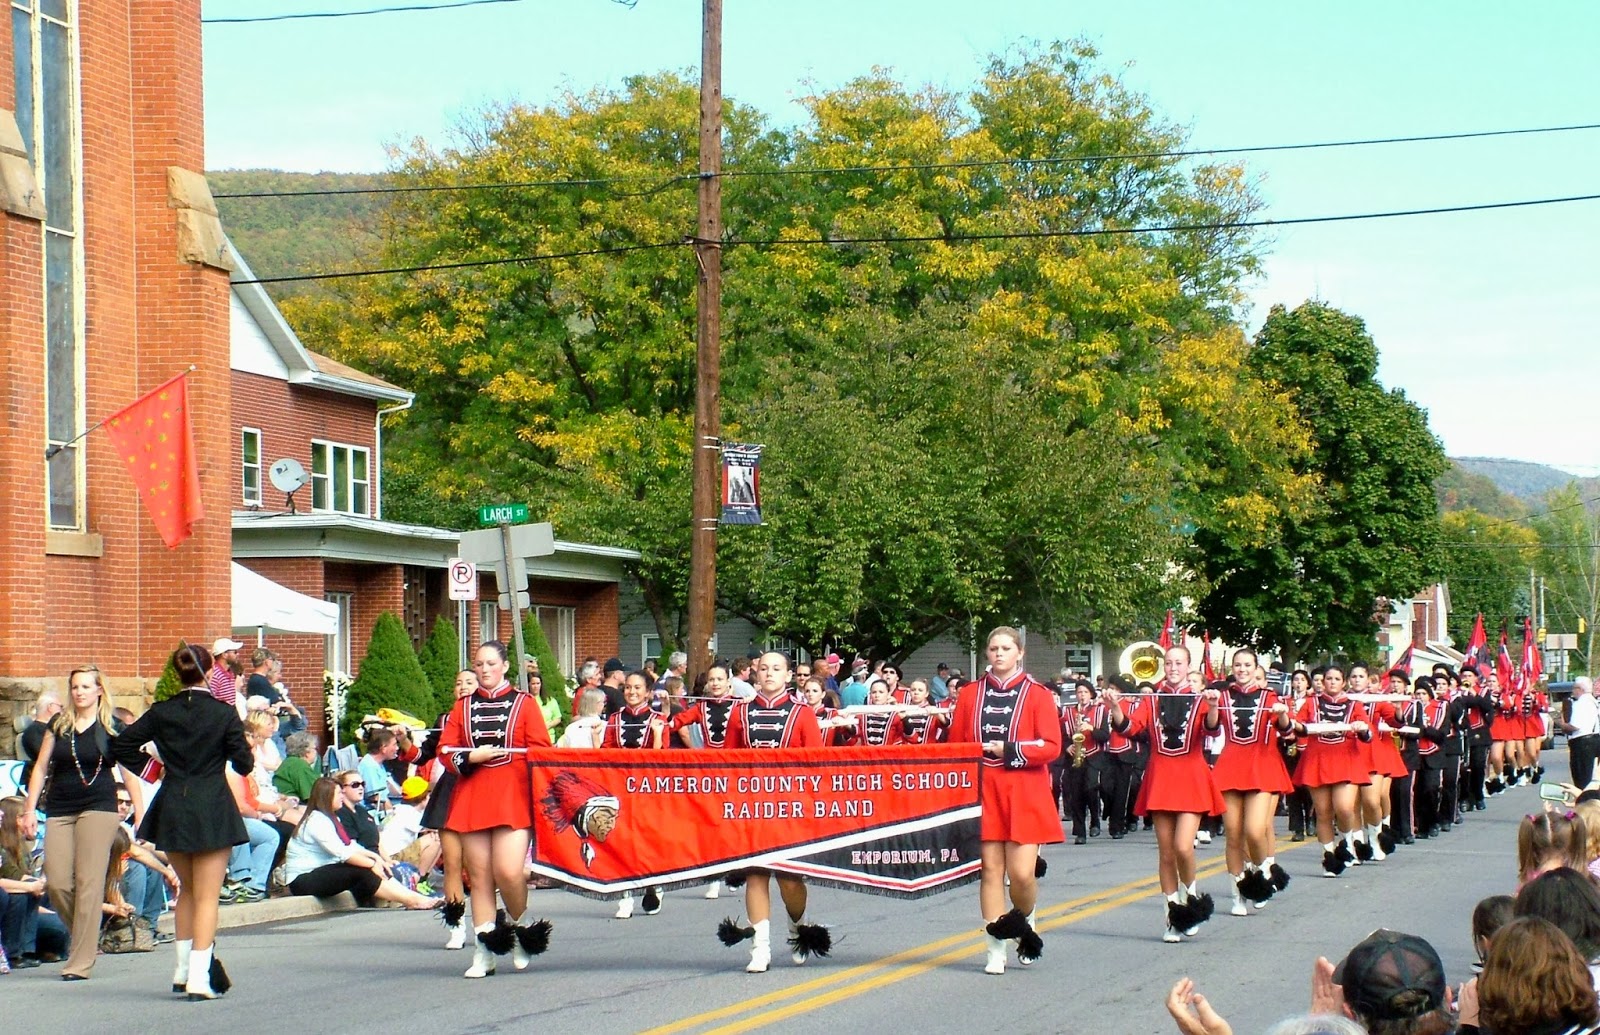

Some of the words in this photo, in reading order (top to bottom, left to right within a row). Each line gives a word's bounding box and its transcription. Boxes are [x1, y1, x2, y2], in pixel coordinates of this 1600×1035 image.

[483, 507, 513, 521] LARCH
[626, 776, 728, 793] CAMERON
[737, 775, 822, 793] COUNTY
[831, 774, 883, 791] HIGH
[892, 771, 972, 790] SCHOOL
[723, 801, 803, 819] RAIDER
[815, 800, 874, 818] BAND
[851, 849, 936, 865] EMPORIUM,
[941, 848, 960, 862] PA
